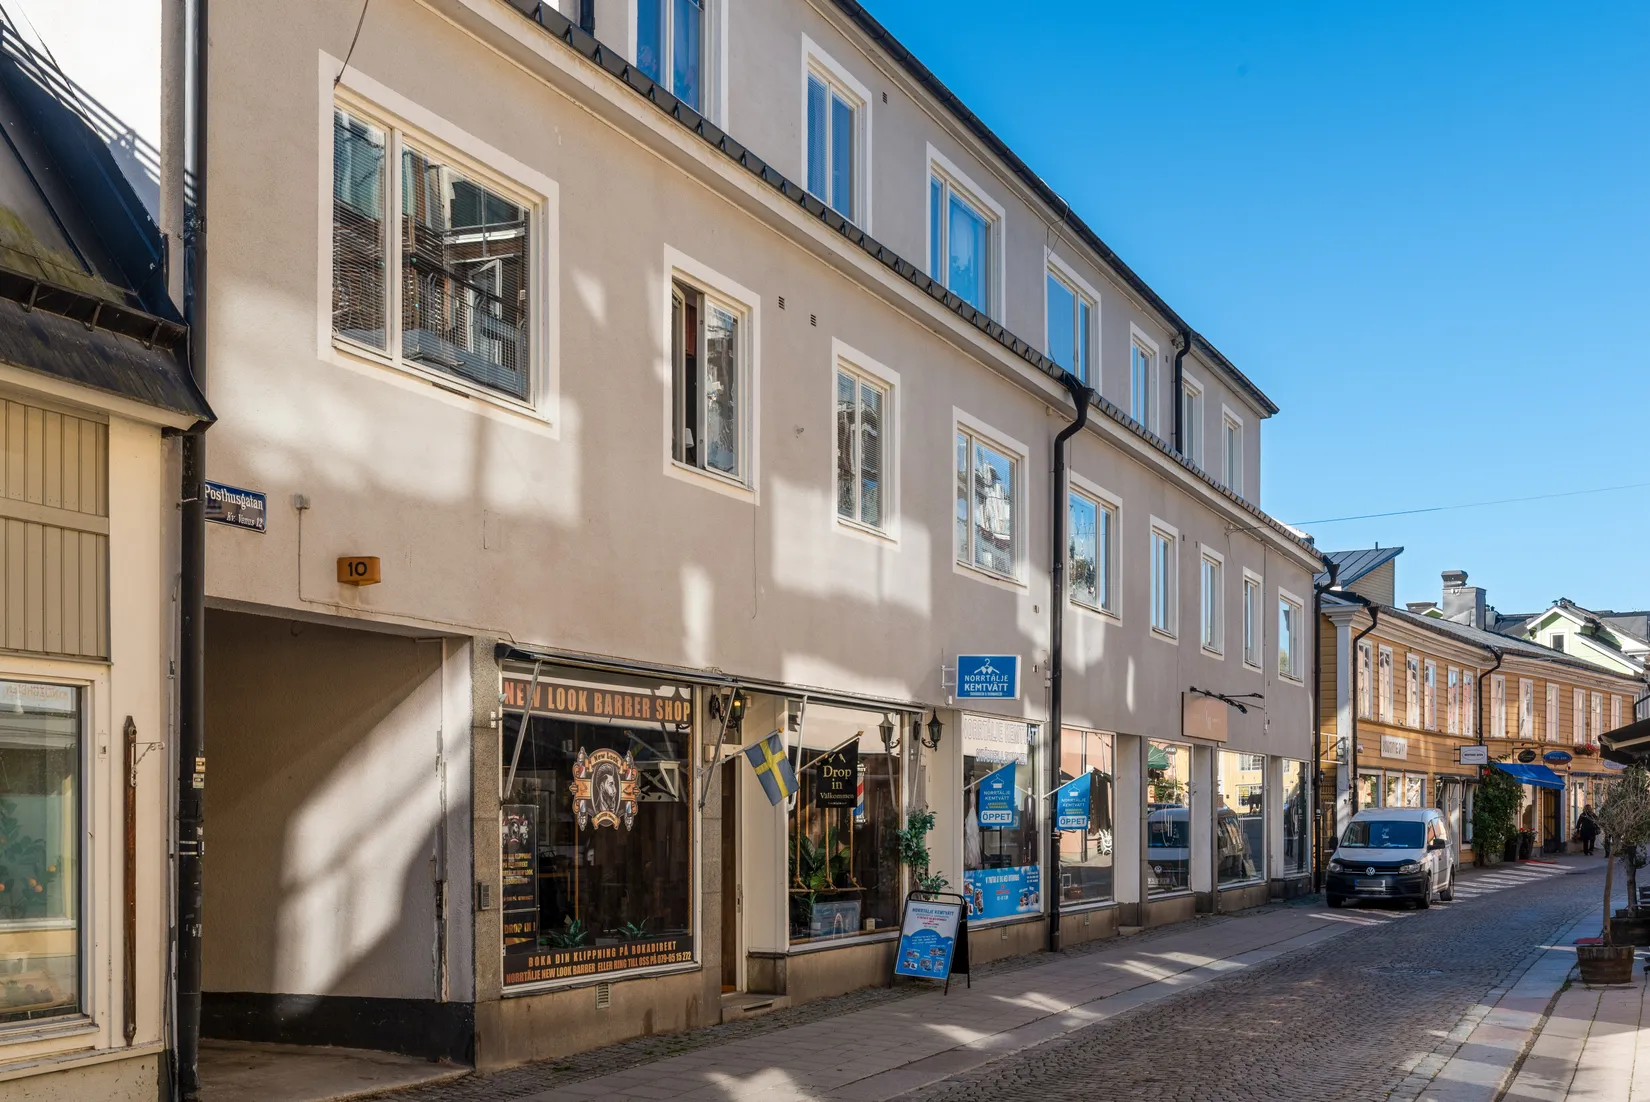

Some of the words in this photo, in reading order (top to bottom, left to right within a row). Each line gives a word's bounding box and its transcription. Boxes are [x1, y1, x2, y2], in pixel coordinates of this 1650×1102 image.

[205, 484, 264, 511] Posthusgatan
[256, 517, 264, 528] 12
[348, 562, 368, 577] 10
[964, 674, 1009, 682] NORRTÄLJE
[964, 682, 1009, 692] KEMTVÄTT
[547, 687, 588, 713] LOOK
[594, 692, 650, 719] BARBER
[655, 698, 691, 722] SHOP
[823, 765, 852, 780] Drop
[831, 778, 843, 789] in
[982, 811, 1011, 821] ÖPPET
[1060, 817, 1086, 825] ÖPPET
[504, 923, 523, 934] DROP
[528, 954, 552, 967] BOKA
[555, 953, 570, 964] DIN
[573, 947, 616, 962] KLIPPNING
[619, 944, 628, 957] PÅ
[631, 941, 677, 955] BOKADIREKT
[506, 969, 541, 984] NORRTÄLJE
[541, 968, 556, 979] NEW
[556, 966, 572, 977] LOOK
[573, 963, 596, 975] BARBER
[597, 960, 613, 972] ELLER
[614, 959, 627, 970] RING
[628, 957, 639, 968] TILL
[639, 956, 650, 966] OSS
[650, 954, 657, 965] PÅ
